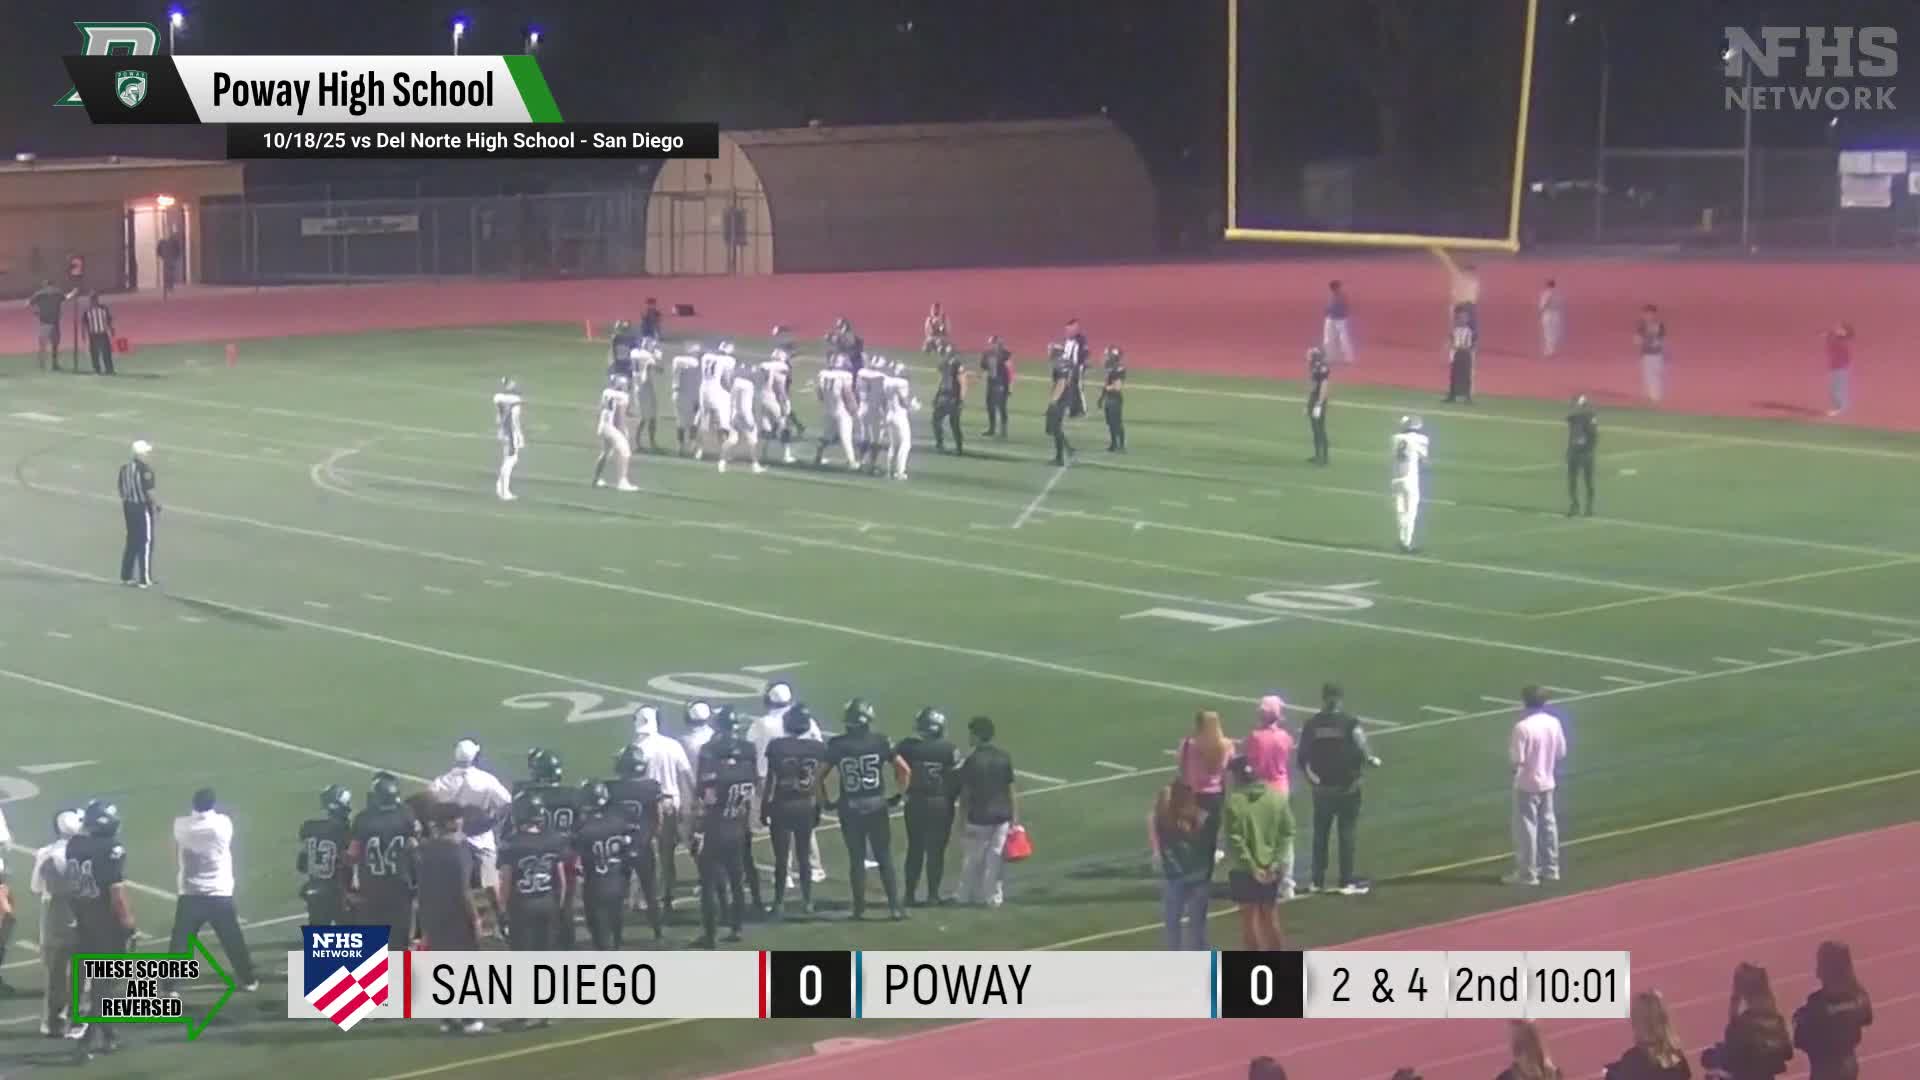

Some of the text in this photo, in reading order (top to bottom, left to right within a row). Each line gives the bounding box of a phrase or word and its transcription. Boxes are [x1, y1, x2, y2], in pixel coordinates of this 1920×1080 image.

[1119, 590, 1375, 632] 10
[501, 671, 769, 725] 20
[839, 744, 881, 793] 65
[304, 836, 338, 880] 13
[367, 835, 405, 876] 44
